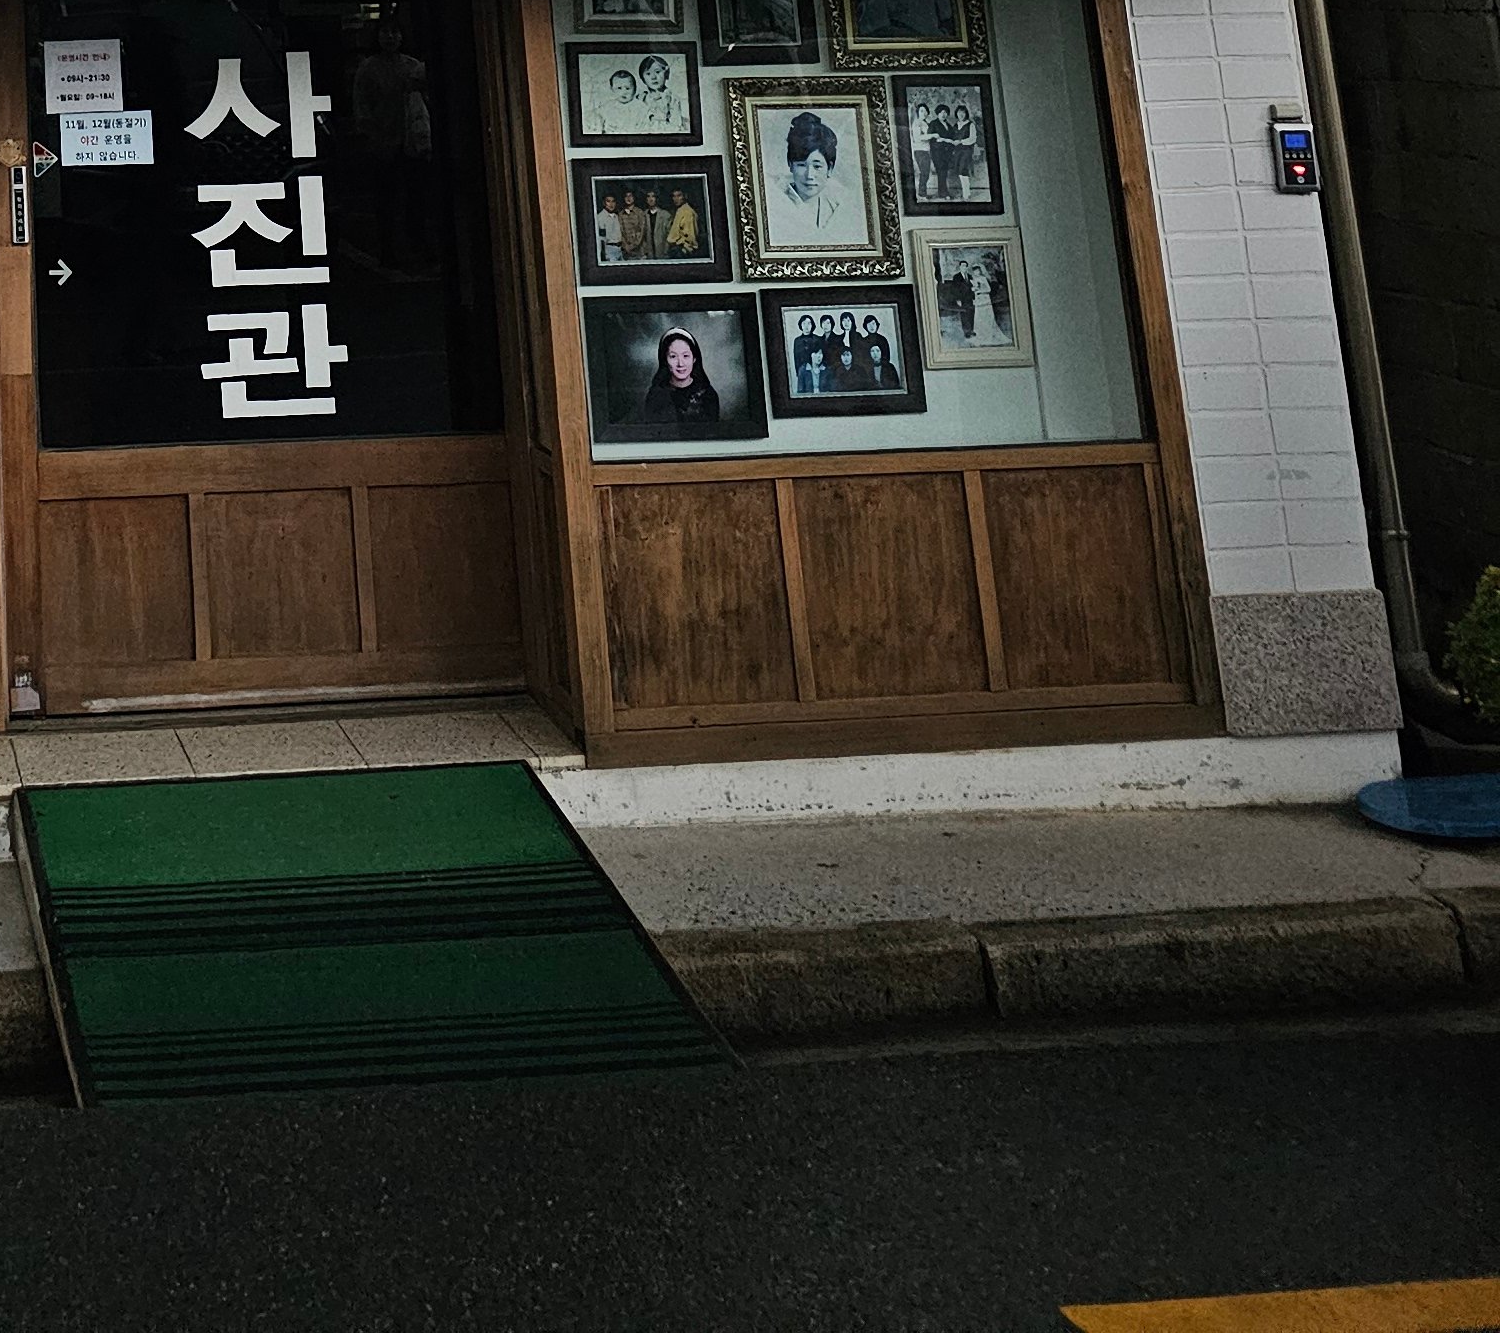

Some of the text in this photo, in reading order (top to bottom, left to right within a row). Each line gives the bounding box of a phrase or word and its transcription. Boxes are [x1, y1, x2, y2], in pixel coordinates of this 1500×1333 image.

[80, 134, 132, 146] 야간 운영을
[75, 152, 94, 162] 하지
[185, 51, 348, 418] 사진관
